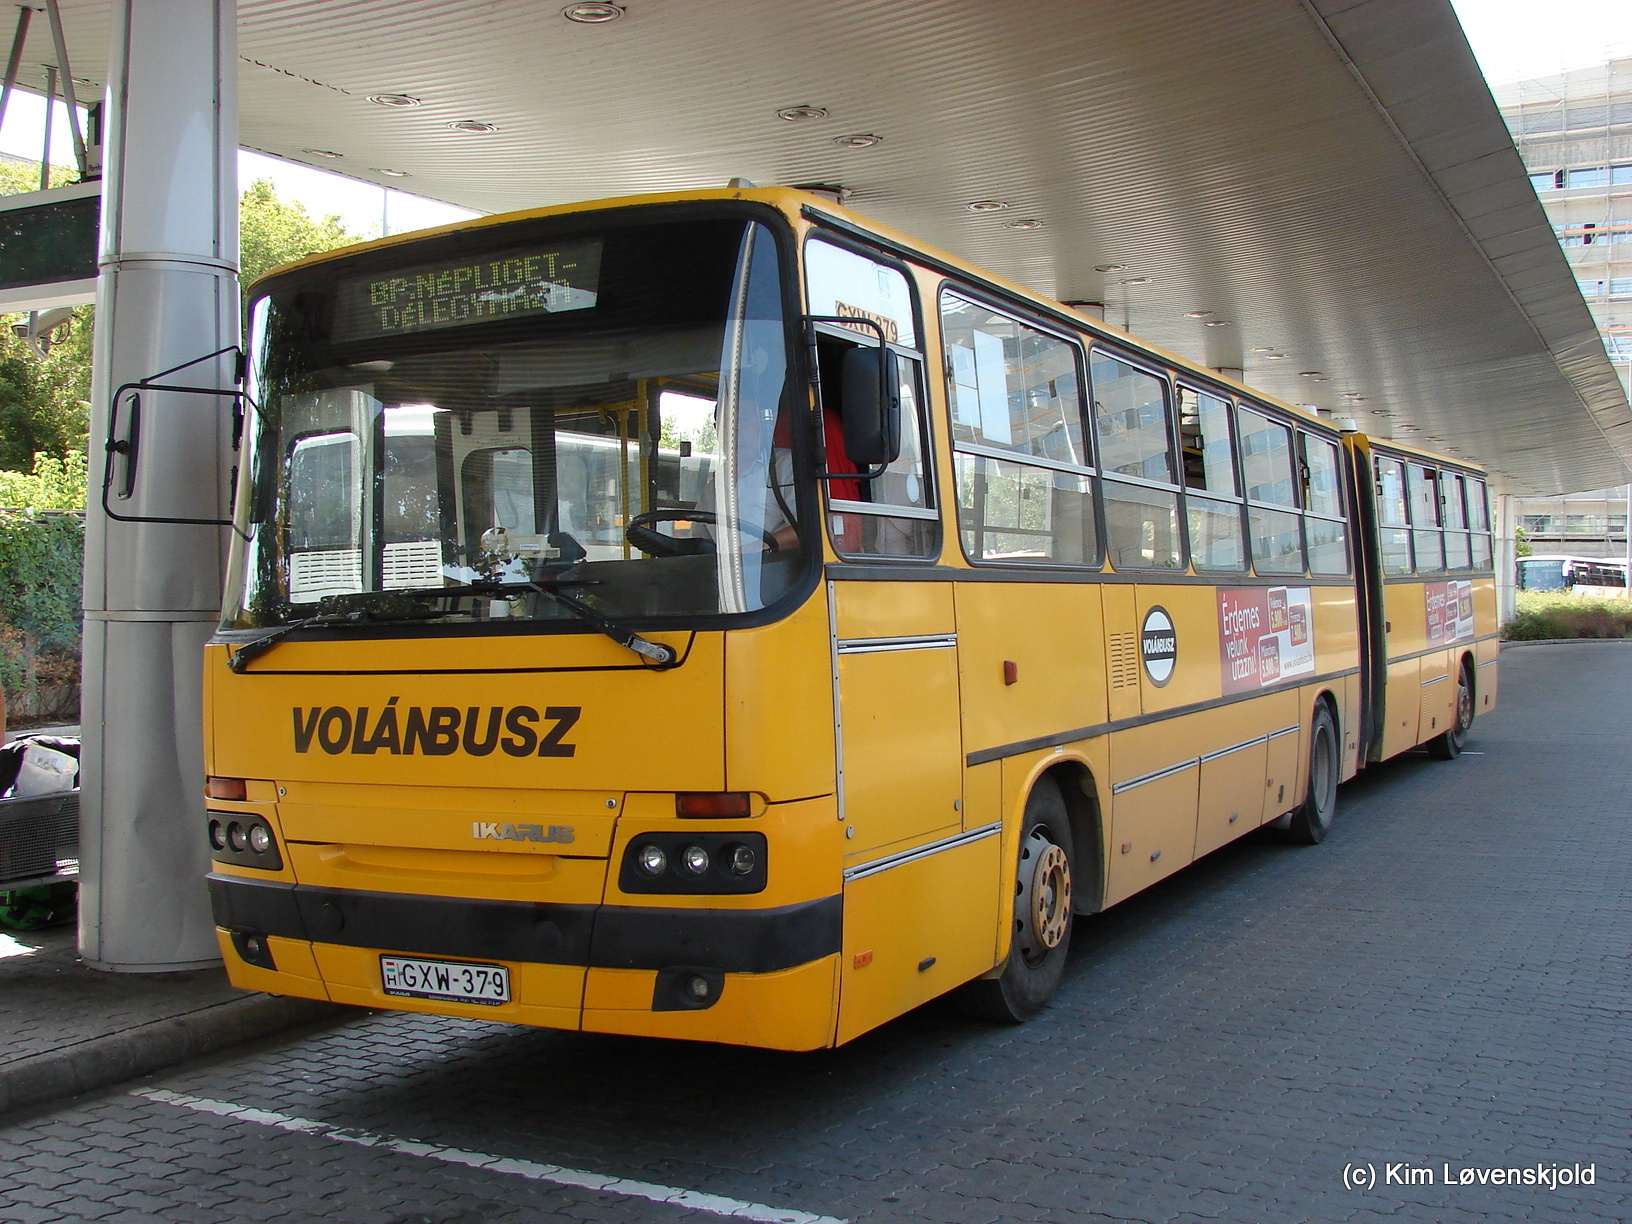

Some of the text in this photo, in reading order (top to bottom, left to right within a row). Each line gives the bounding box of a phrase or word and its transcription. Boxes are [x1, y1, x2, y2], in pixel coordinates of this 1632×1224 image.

[837, 302, 898, 342] GXW379
[1222, 593, 1260, 636] Érdemes
[1143, 635, 1175, 655] VOLÁNBUSZ
[1226, 630, 1249, 660] velünk
[1231, 646, 1257, 681] utazni!
[292, 696, 582, 758] VOLÁNBUSZ
[472, 821, 575, 844] IKARUS
[386, 963, 504, 997] H GXW-379
